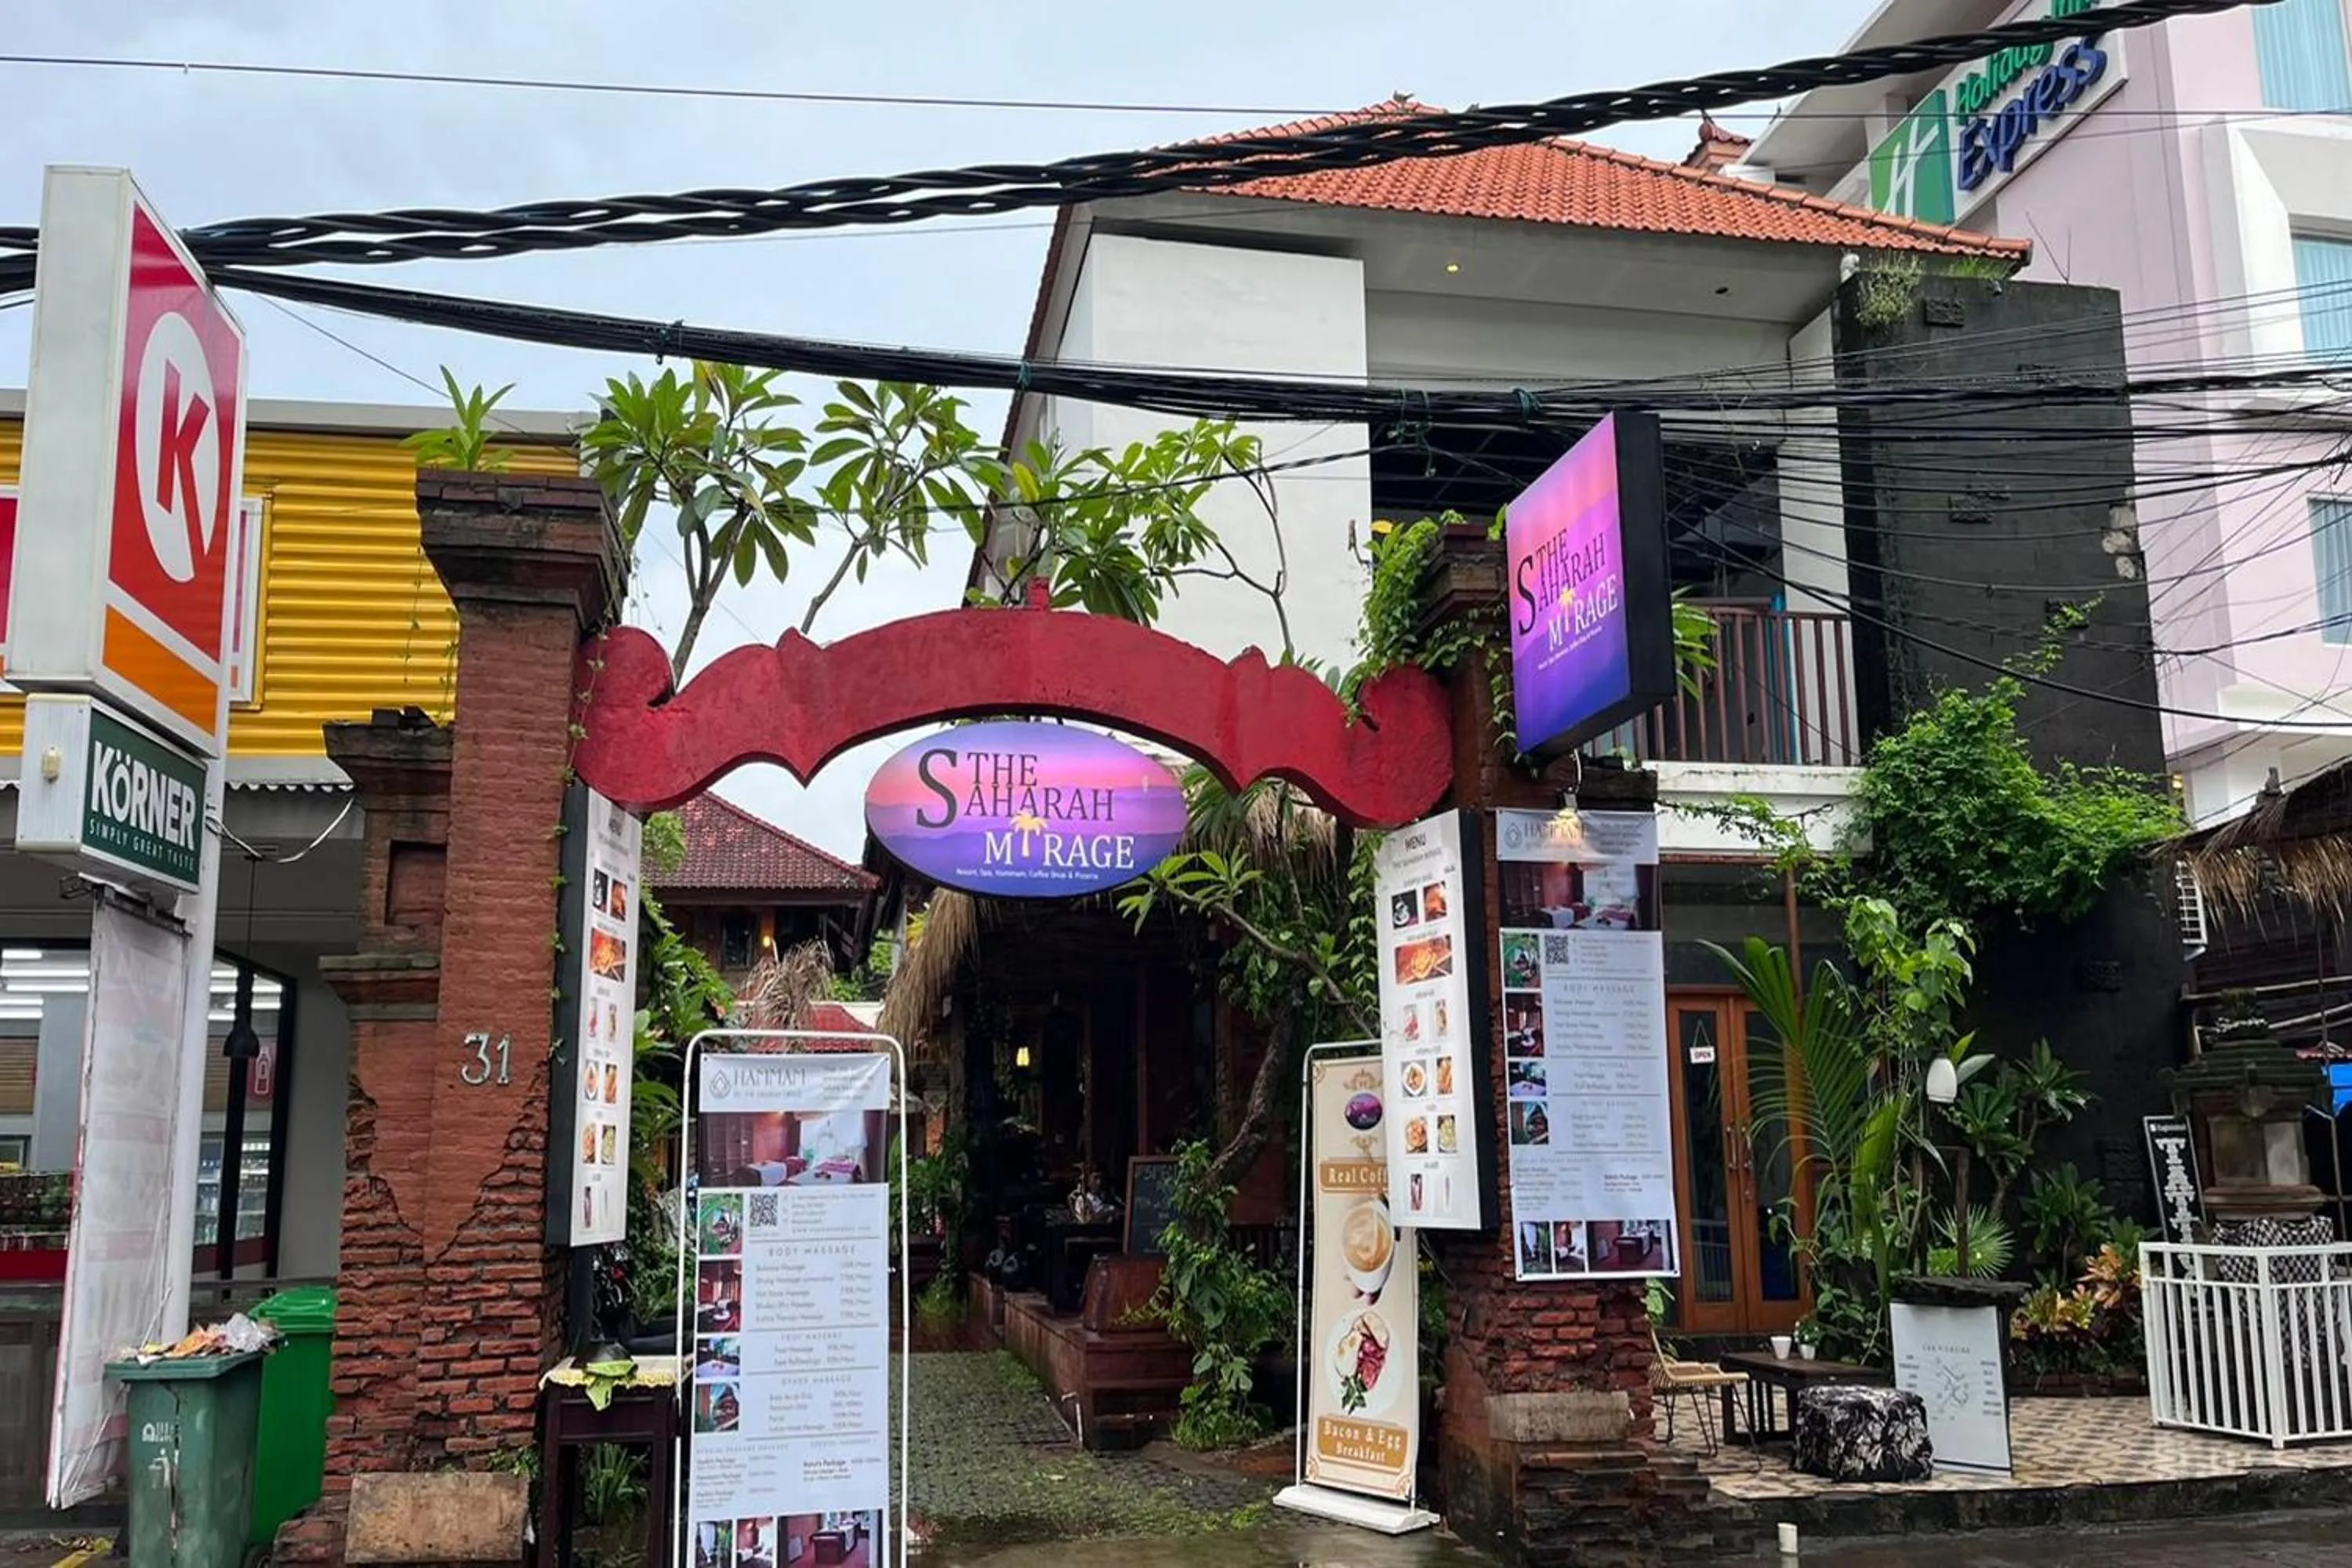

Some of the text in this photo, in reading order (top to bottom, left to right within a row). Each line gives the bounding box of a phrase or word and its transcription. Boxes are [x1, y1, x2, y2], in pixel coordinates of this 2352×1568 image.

[1535, 527, 1568, 583] THE
[966, 752, 1039, 786] THE
[92, 739, 195, 851] KÖRNER
[89, 818, 194, 872] SIMPLY GREAT TASTE
[461, 1033, 510, 1085] 31
[734, 1065, 806, 1087] HAMMAM
[1329, 1165, 1356, 1184] Real
[1323, 1420, 1359, 1441] Bacon
[1365, 1427, 1374, 1443] &
[1335, 1441, 1387, 1463] Breakfast
